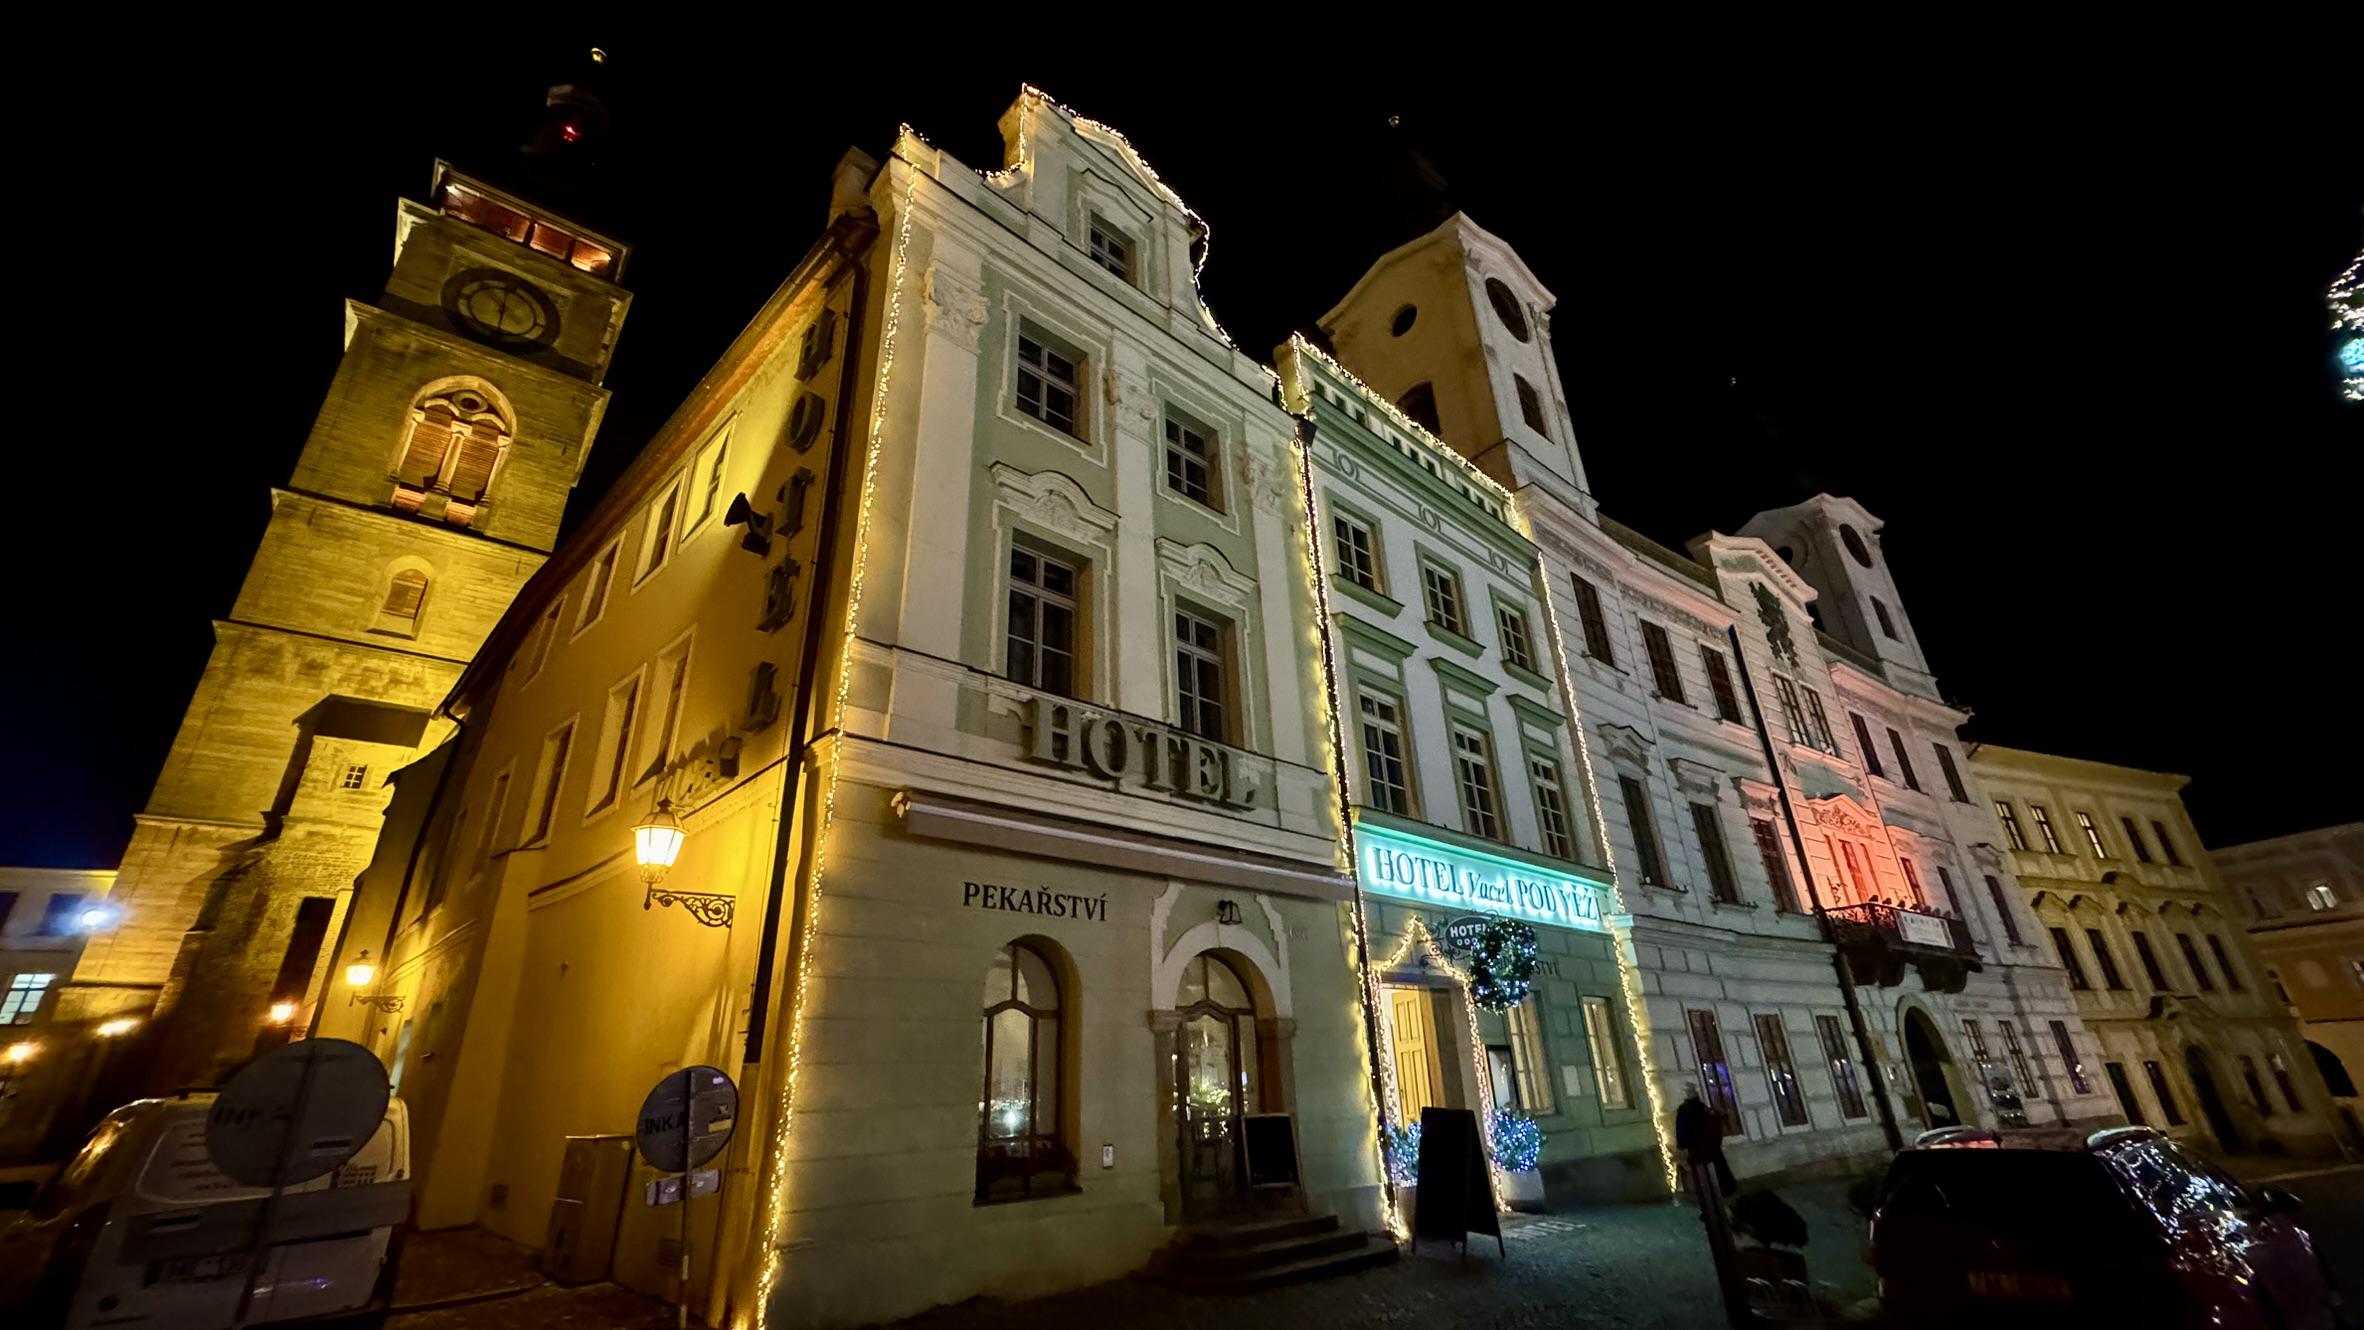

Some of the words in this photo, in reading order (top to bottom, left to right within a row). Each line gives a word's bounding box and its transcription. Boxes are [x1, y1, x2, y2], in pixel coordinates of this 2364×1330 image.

[1028, 697, 1255, 810] HOTEL
[963, 881, 1107, 922] PEKAŘSTVÍ
[1373, 847, 1464, 895] HOTEL
[1516, 879, 1557, 912] POD
